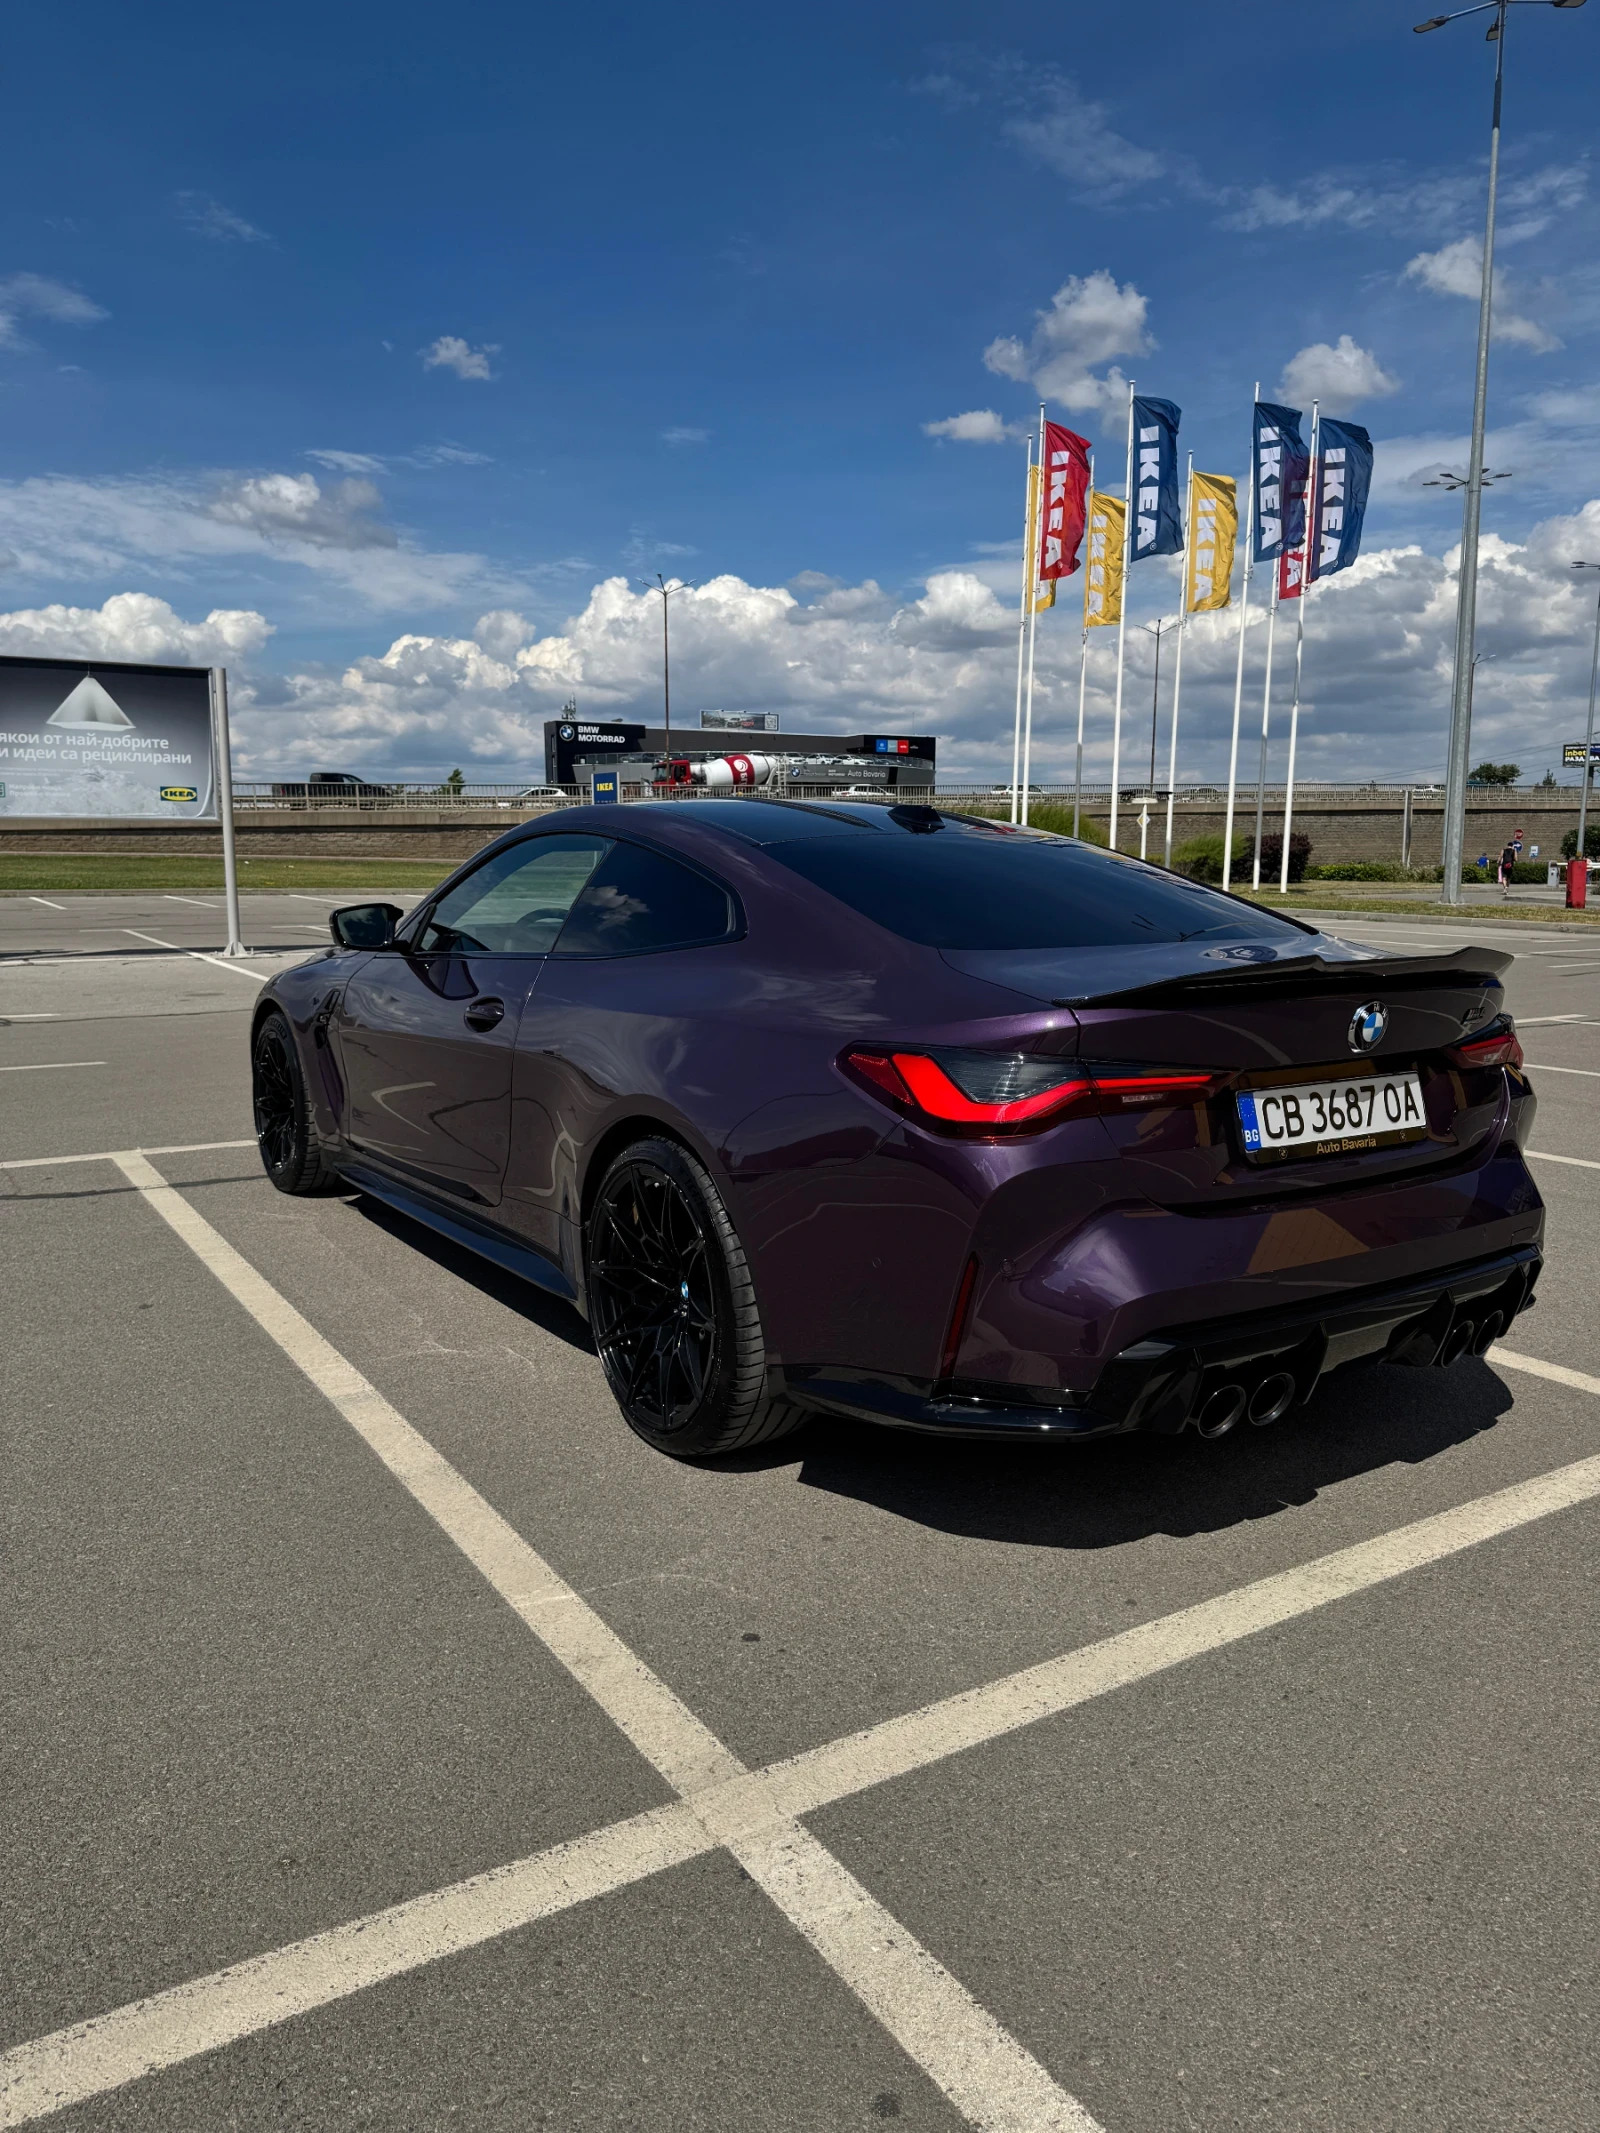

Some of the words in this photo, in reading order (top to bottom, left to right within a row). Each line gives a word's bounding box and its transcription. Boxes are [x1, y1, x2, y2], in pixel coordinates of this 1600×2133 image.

[1138, 426, 1160, 551] IKEA
[1260, 426, 1282, 550] IKEA
[1045, 451, 1070, 569] IKEA
[1319, 448, 1346, 568] IKEA
[1194, 498, 1217, 603] IKEA
[1088, 515, 1107, 616] IKEA
[577, 725, 600, 734] BMW
[578, 734, 626, 743] MOTORRAD
[43, 734, 63, 745] от
[66, 732, 169, 751] най-добрите
[13, 747, 57, 762] идеи
[60, 749, 78, 760] са
[82, 750, 192, 766] рециклирани
[847, 769, 862, 778] Auto
[863, 769, 886, 778] Bavaria
[163, 790, 195, 798] IKEA
[596, 782, 614, 791] IKEA
[1262, 1094, 1305, 1140] CB
[1309, 1084, 1376, 1134] 3687
[1383, 1080, 1420, 1123] OA
[1244, 1129, 1259, 1143] BG
[1316, 1140, 1341, 1155] Auto
[1342, 1135, 1377, 1151] Bavaria
